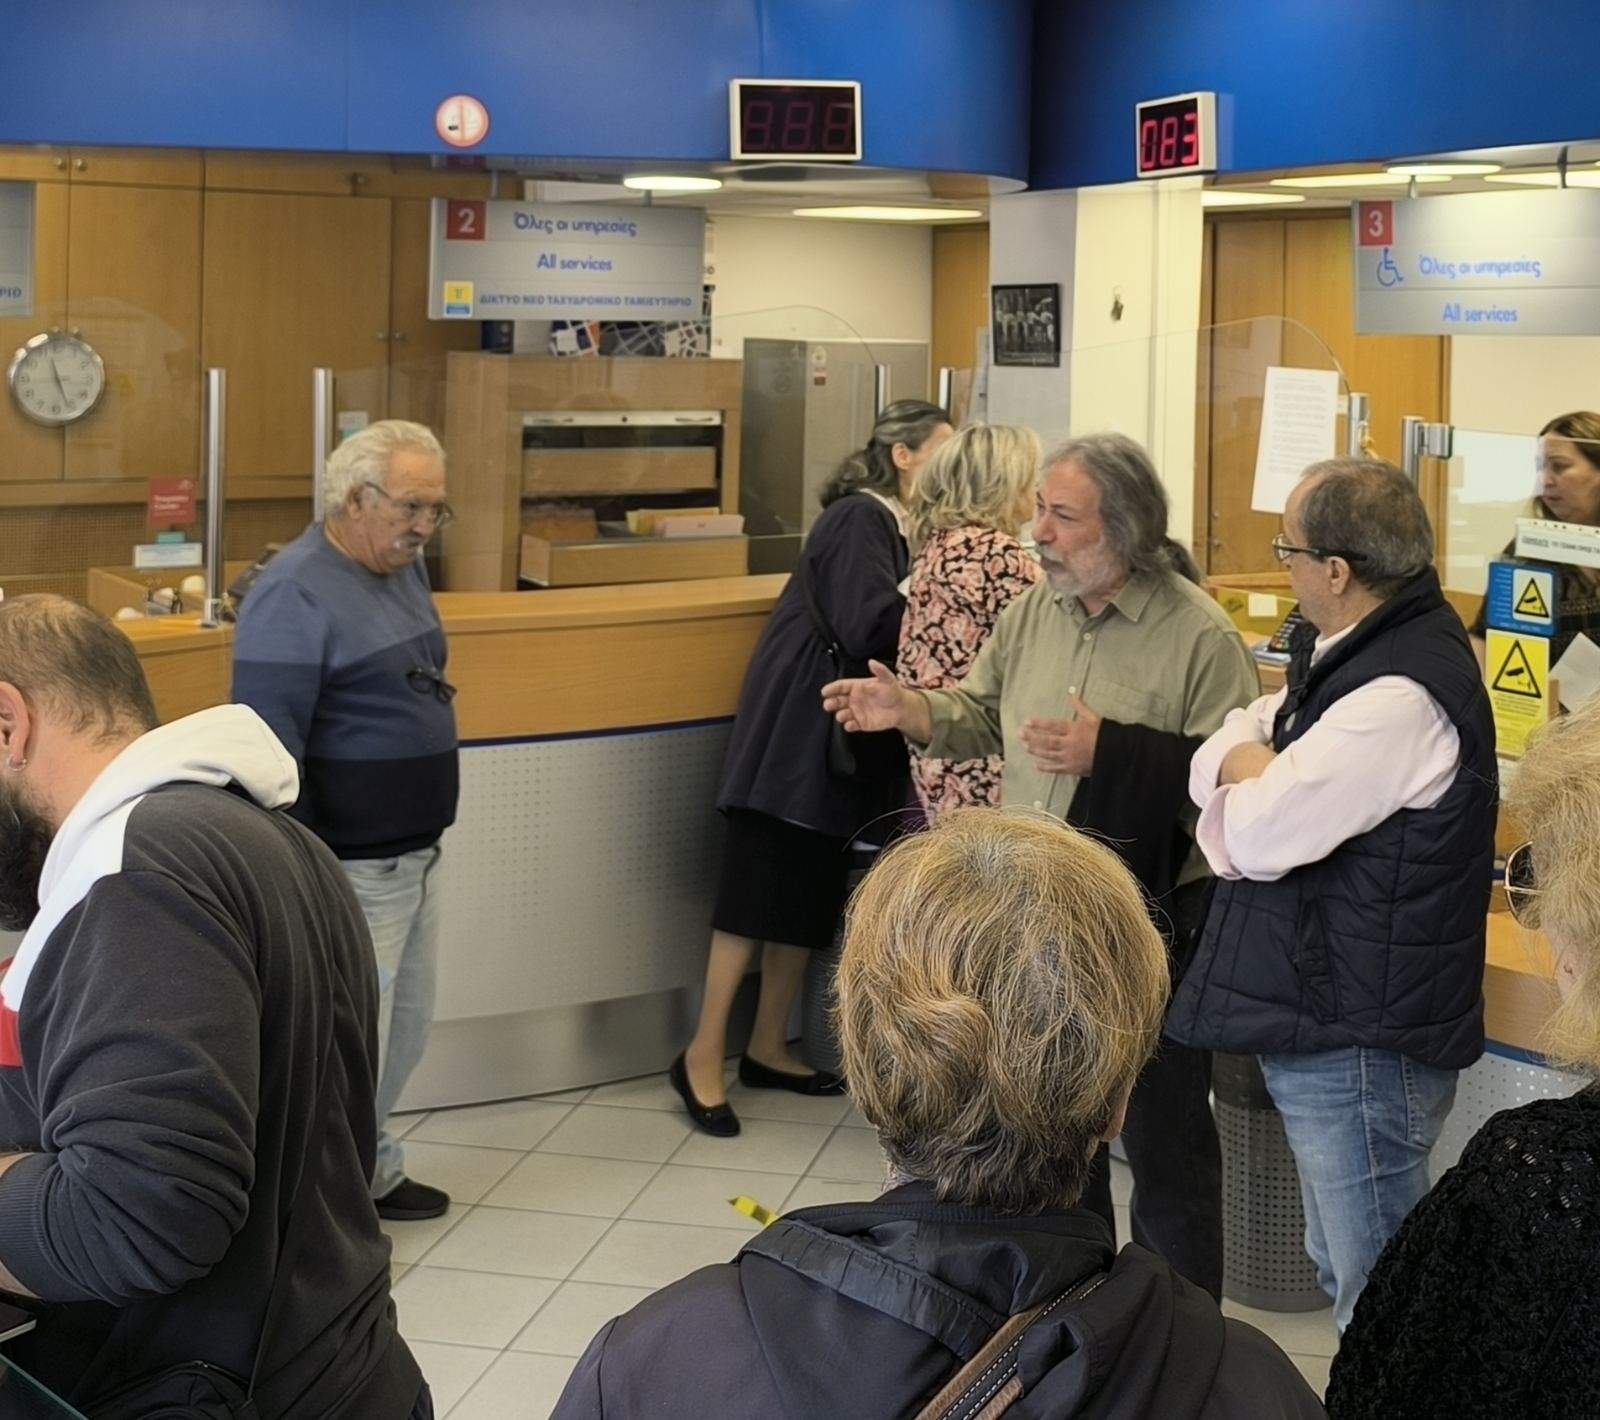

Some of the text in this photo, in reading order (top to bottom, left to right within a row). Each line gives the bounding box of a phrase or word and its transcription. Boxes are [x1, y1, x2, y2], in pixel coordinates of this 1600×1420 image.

[1141, 112, 1197, 169] 083
[458, 207, 476, 234] 2
[1368, 209, 1384, 238] 3
[537, 253, 613, 271] All services
[1442, 303, 1518, 323] All services
